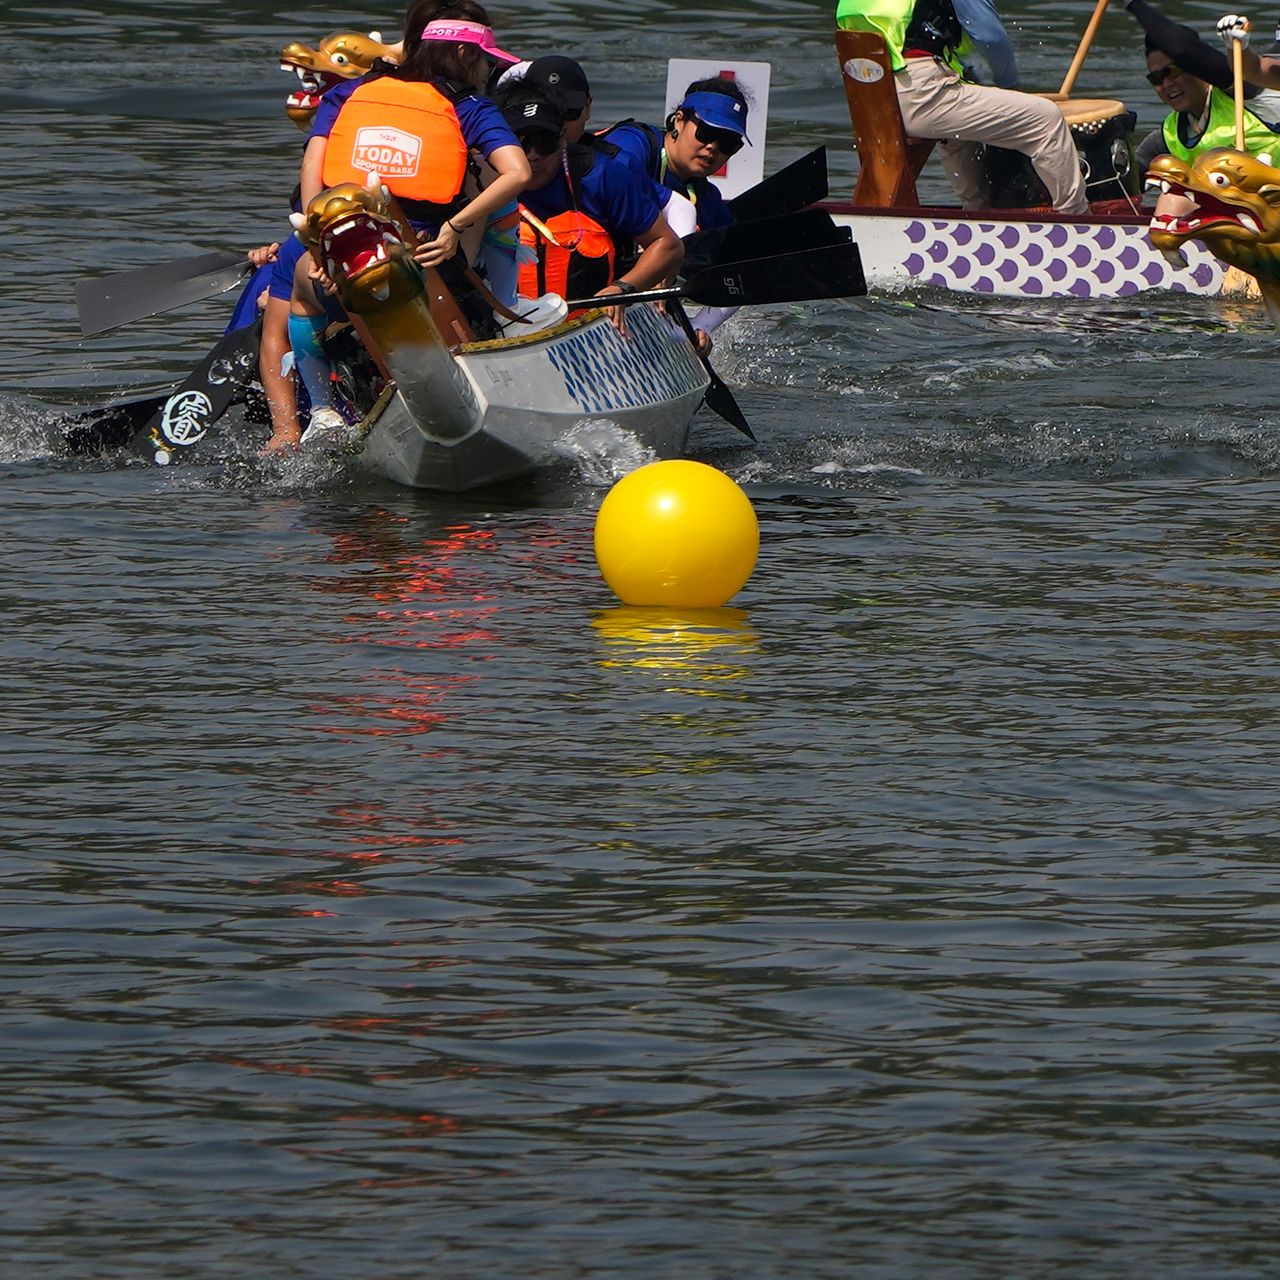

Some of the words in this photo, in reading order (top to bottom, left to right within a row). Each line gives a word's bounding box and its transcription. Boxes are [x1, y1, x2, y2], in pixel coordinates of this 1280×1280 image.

[357, 146, 417, 166] TODAY
[354, 157, 388, 172] SPORTS
[389, 164, 414, 174] BASE
